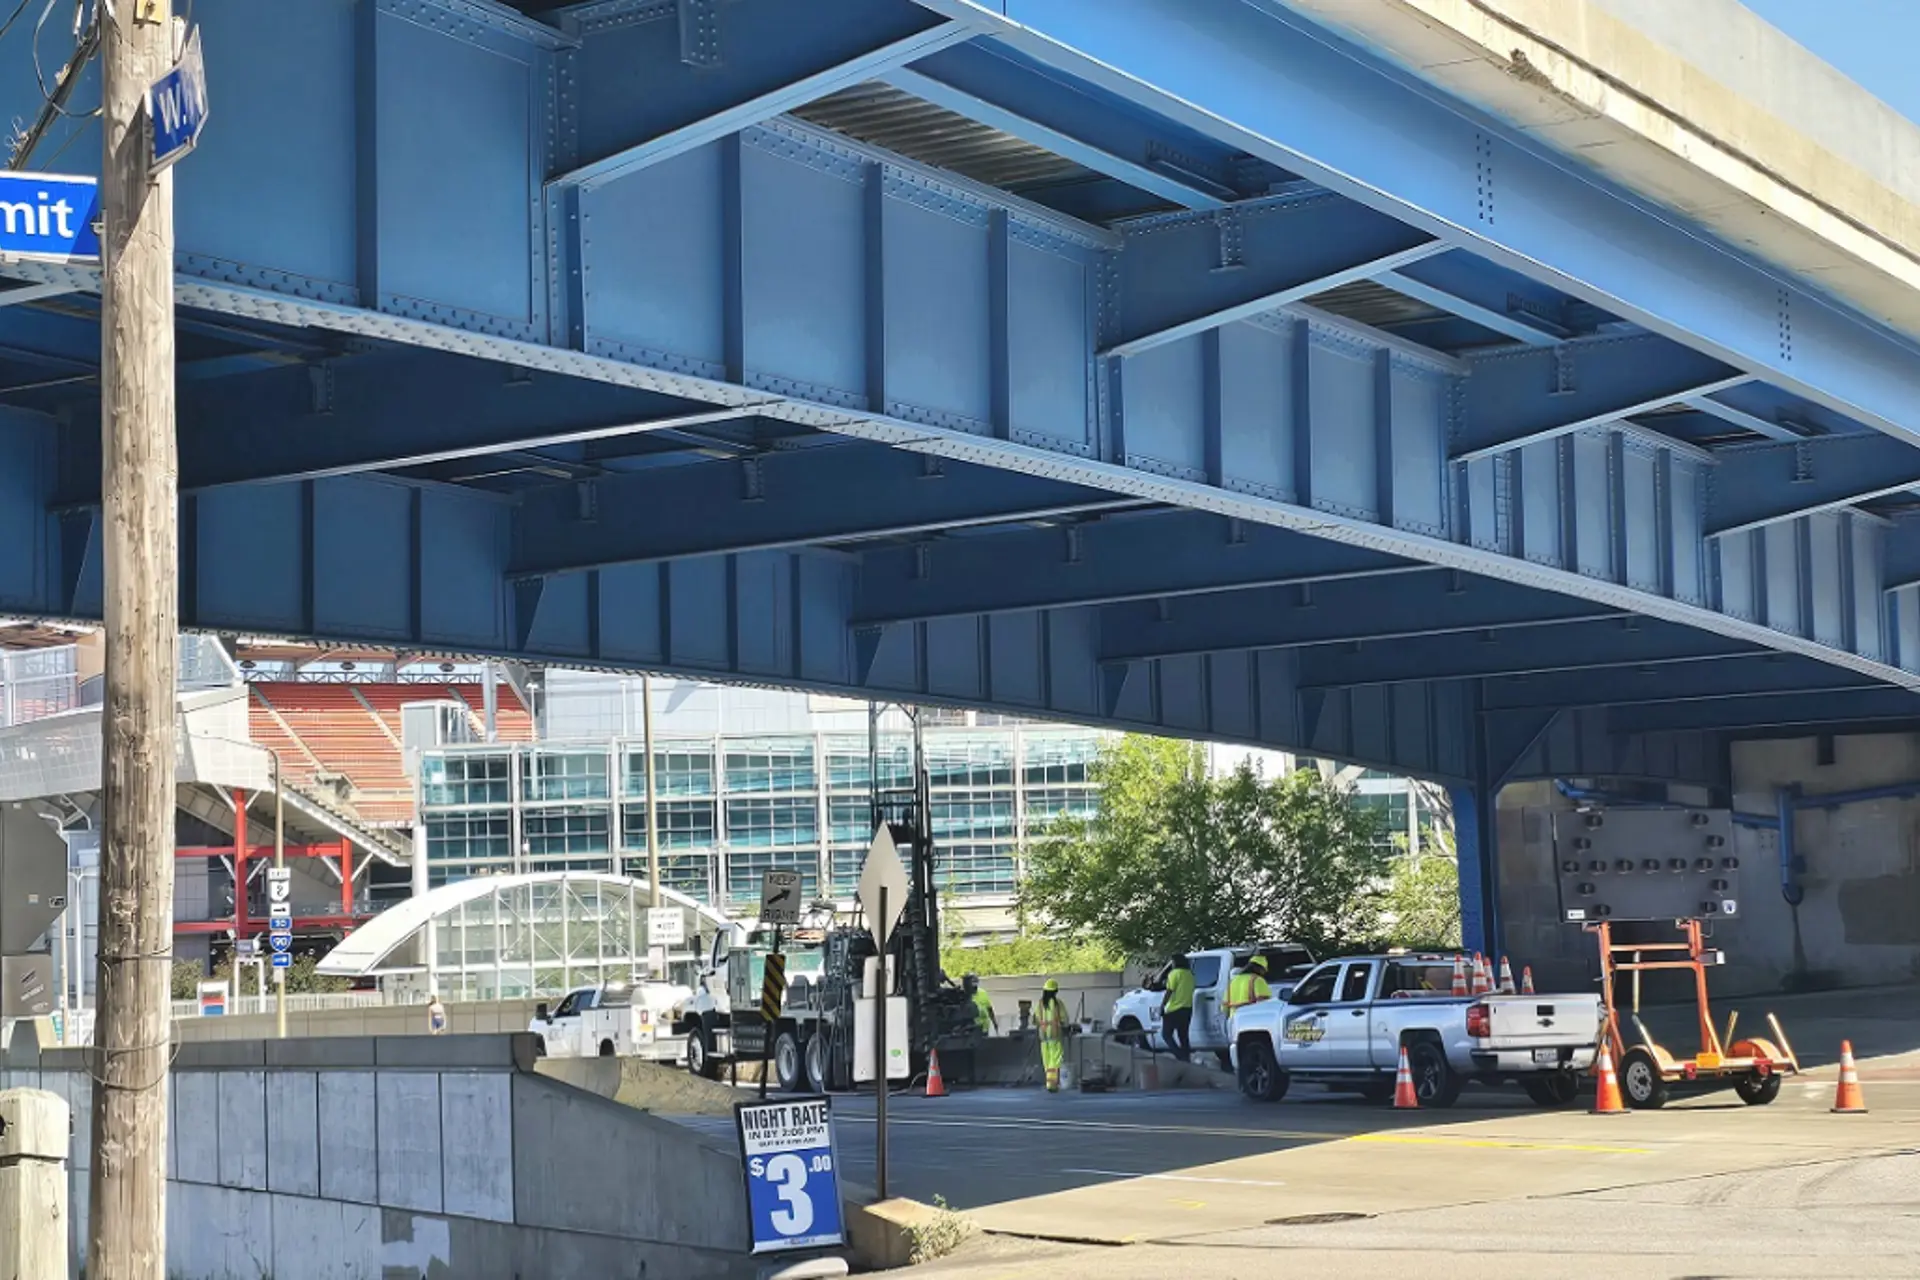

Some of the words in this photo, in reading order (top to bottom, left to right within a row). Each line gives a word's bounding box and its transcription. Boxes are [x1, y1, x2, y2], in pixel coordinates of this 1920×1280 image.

[769, 874, 796, 885] KEEP
[763, 909, 797, 920] RIGHT
[273, 937, 289, 947] 90
[743, 1107, 787, 1130] NIGHT
[792, 1103, 828, 1127] RATE
[748, 1131, 761, 1140] IN
[764, 1130, 778, 1139] BY
[806, 1126, 824, 1135] PM
